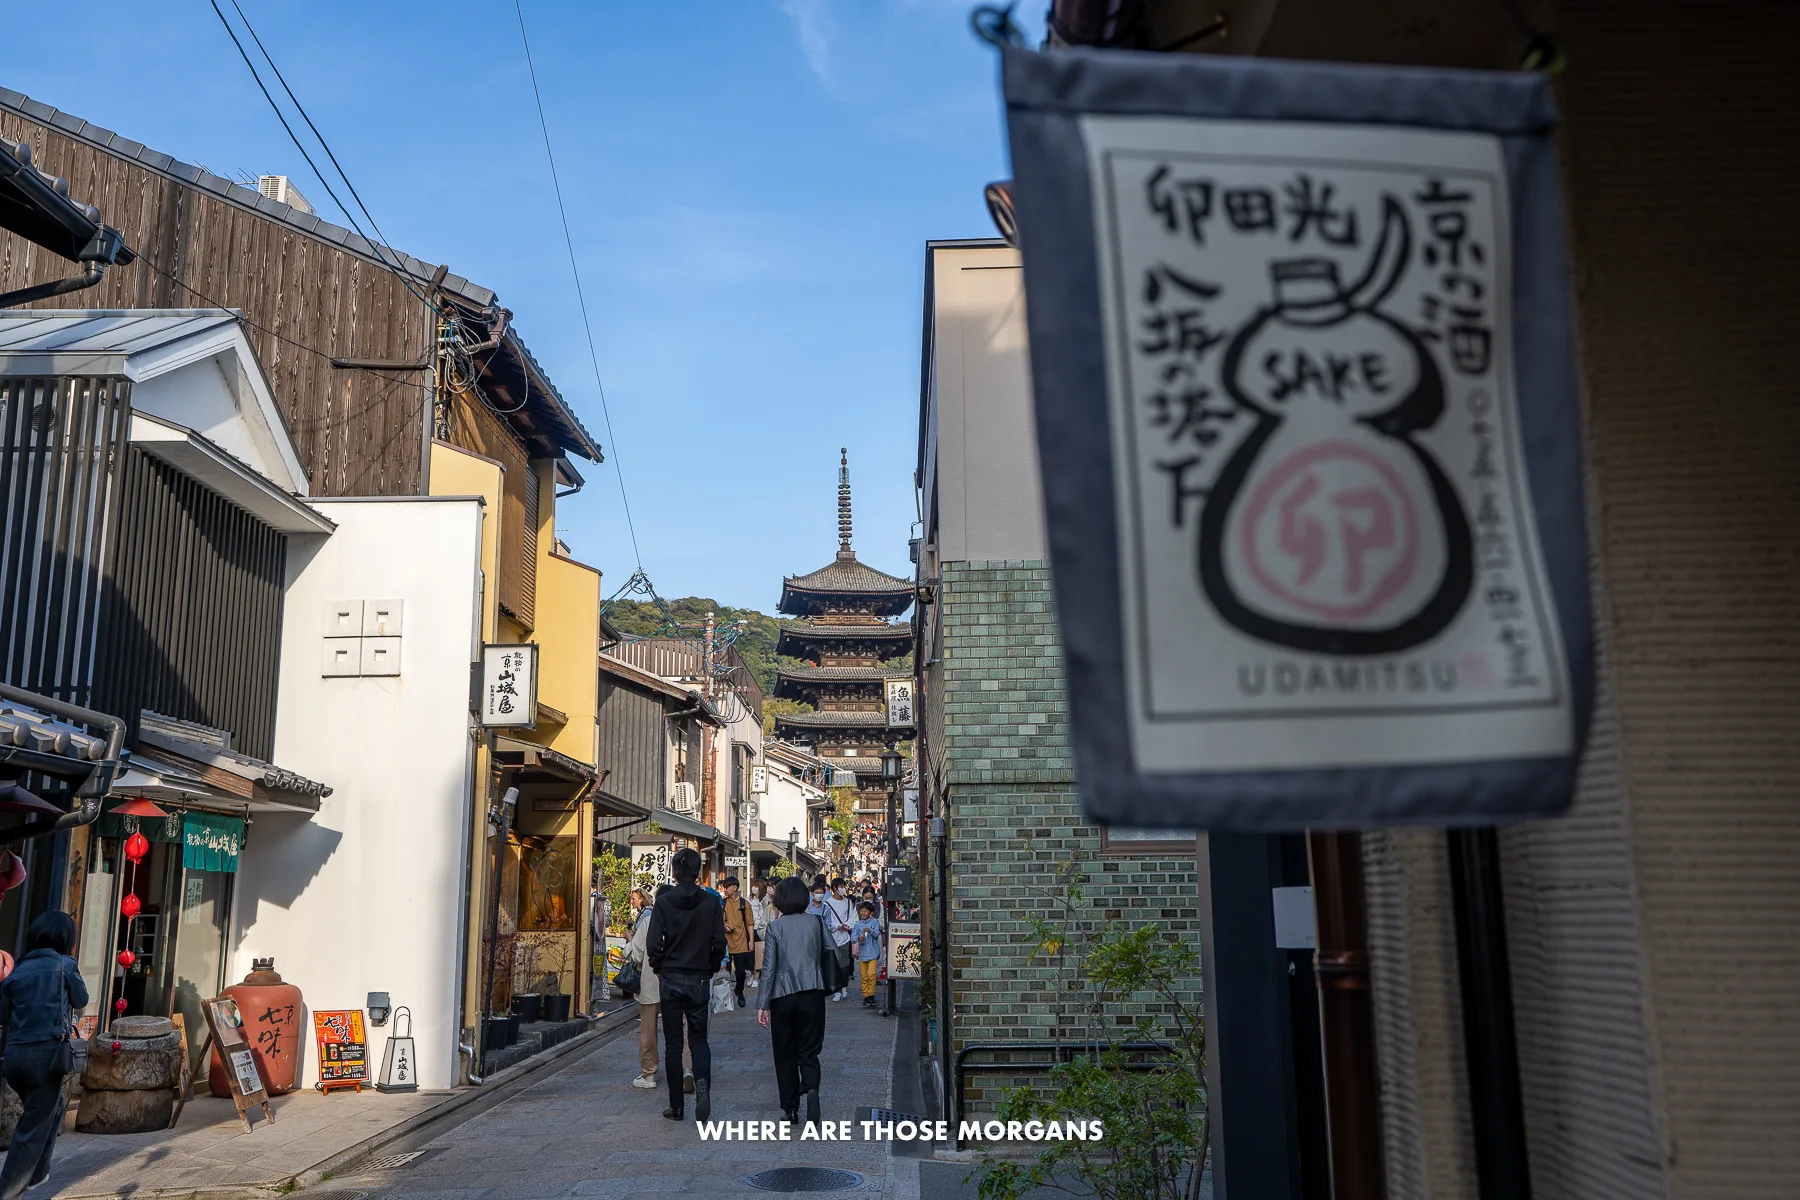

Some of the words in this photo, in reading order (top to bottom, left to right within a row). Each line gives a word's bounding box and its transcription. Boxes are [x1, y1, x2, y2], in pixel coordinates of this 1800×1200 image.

[1143, 164, 1361, 249] 卯田光
[1412, 179, 1493, 377] 京の酒
[1137, 263, 1236, 529] 八坂の塔下
[1261, 350, 1394, 402] SAKE
[496, 653, 518, 714] 京山城屋
[897, 686, 911, 722] 魚藤
[1236, 661, 1460, 697] UDAMITSU
[895, 944, 908, 974] 魚藤
[258, 1007, 283, 1059] 七味
[324, 1016, 351, 1044] 七味
[397, 1047, 409, 1081] 京山城屋
